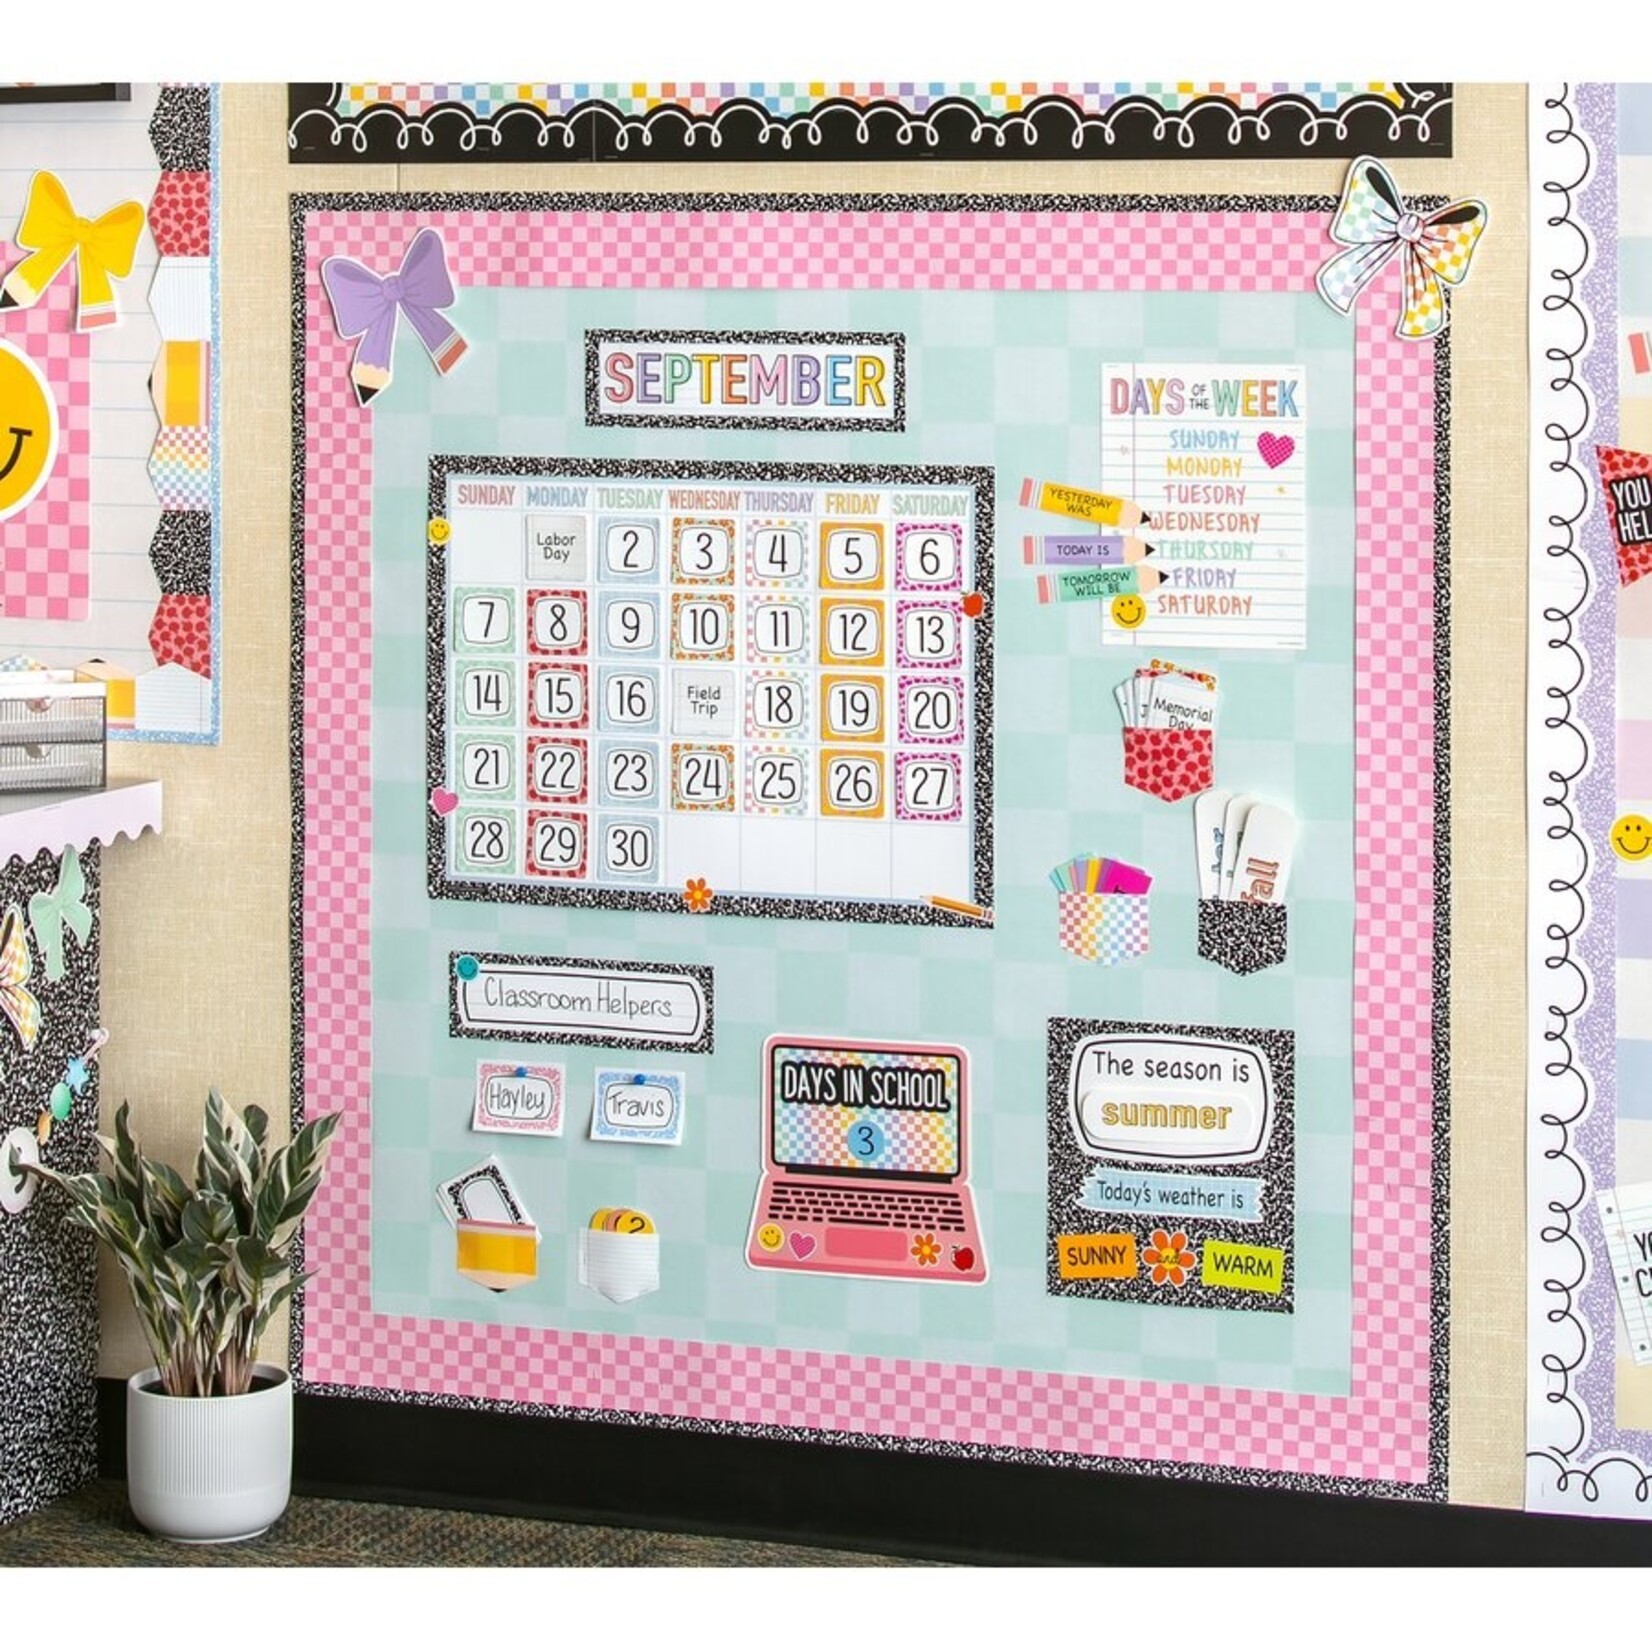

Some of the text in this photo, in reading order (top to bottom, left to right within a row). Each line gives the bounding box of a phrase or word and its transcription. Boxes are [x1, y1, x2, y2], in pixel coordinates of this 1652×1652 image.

[604, 353, 885, 406] SEPTEMBER
[1110, 378, 1299, 417] DAYS OF THE WEEK
[1169, 428, 1240, 449] SUNDAY
[1167, 456, 1243, 477] MONDAY
[458, 484, 968, 517] SUNDAY MONDAY TUESDAY WEDNESDAY THURSDAY FRIDAY SATURDAY
[1050, 488, 1112, 509] YESTERDAY
[1066, 503, 1092, 517] WAS
[1163, 484, 1246, 506] TUESDAY
[1612, 477, 1651, 510] YOU
[537, 533, 576, 546] Labor
[1148, 511, 1261, 533] WEDNESDAY
[543, 546, 570, 563] Day
[623, 531, 640, 568] 2
[697, 533, 712, 569] 3
[769, 535, 787, 572] 4
[845, 538, 862, 574] 5
[920, 539, 939, 575] 6
[1057, 545, 1110, 555] TODAY IS
[1157, 540, 1254, 561] THURSDAY
[1063, 571, 1131, 586] TOMORROW
[1074, 583, 1121, 597] WILL BE
[1173, 568, 1237, 590] FRIDAY
[479, 602, 494, 637] 7
[550, 604, 567, 641] 8
[1158, 594, 1252, 617] SATURDAY
[622, 607, 639, 643] 9
[690, 609, 718, 645] 10
[771, 611, 789, 646] 11
[840, 613, 866, 650] 12
[917, 616, 944, 653] 13
[474, 675, 501, 711] 14
[545, 677, 574, 714] 15
[617, 681, 645, 716] 16
[687, 685, 721, 700] Field
[690, 700, 719, 718] Trip
[765, 686, 793, 723] 18
[838, 688, 870, 726] 19
[914, 691, 950, 729] 20
[1154, 697, 1213, 722] Memorial
[472, 747, 501, 784] 21
[541, 749, 576, 789] 22
[614, 751, 649, 791] 23
[686, 758, 721, 796] 24
[761, 762, 795, 799] 25
[835, 764, 872, 803] 26
[912, 767, 948, 806] 27
[471, 821, 505, 859] 28
[539, 825, 576, 863] 29
[613, 829, 648, 866] 30
[484, 976, 673, 1020] Classroom Helpers
[1092, 1050, 1250, 1083] The season is
[490, 1084, 546, 1118] Hayley
[609, 1091, 665, 1117] Travis
[784, 1065, 947, 1108] DAYS IN SCHOOL
[1102, 1101, 1232, 1129] summer
[858, 1126, 875, 1156] 3
[1097, 1180, 1244, 1209] Today's weather is
[1067, 1245, 1274, 1279] SUNNY and WARM
